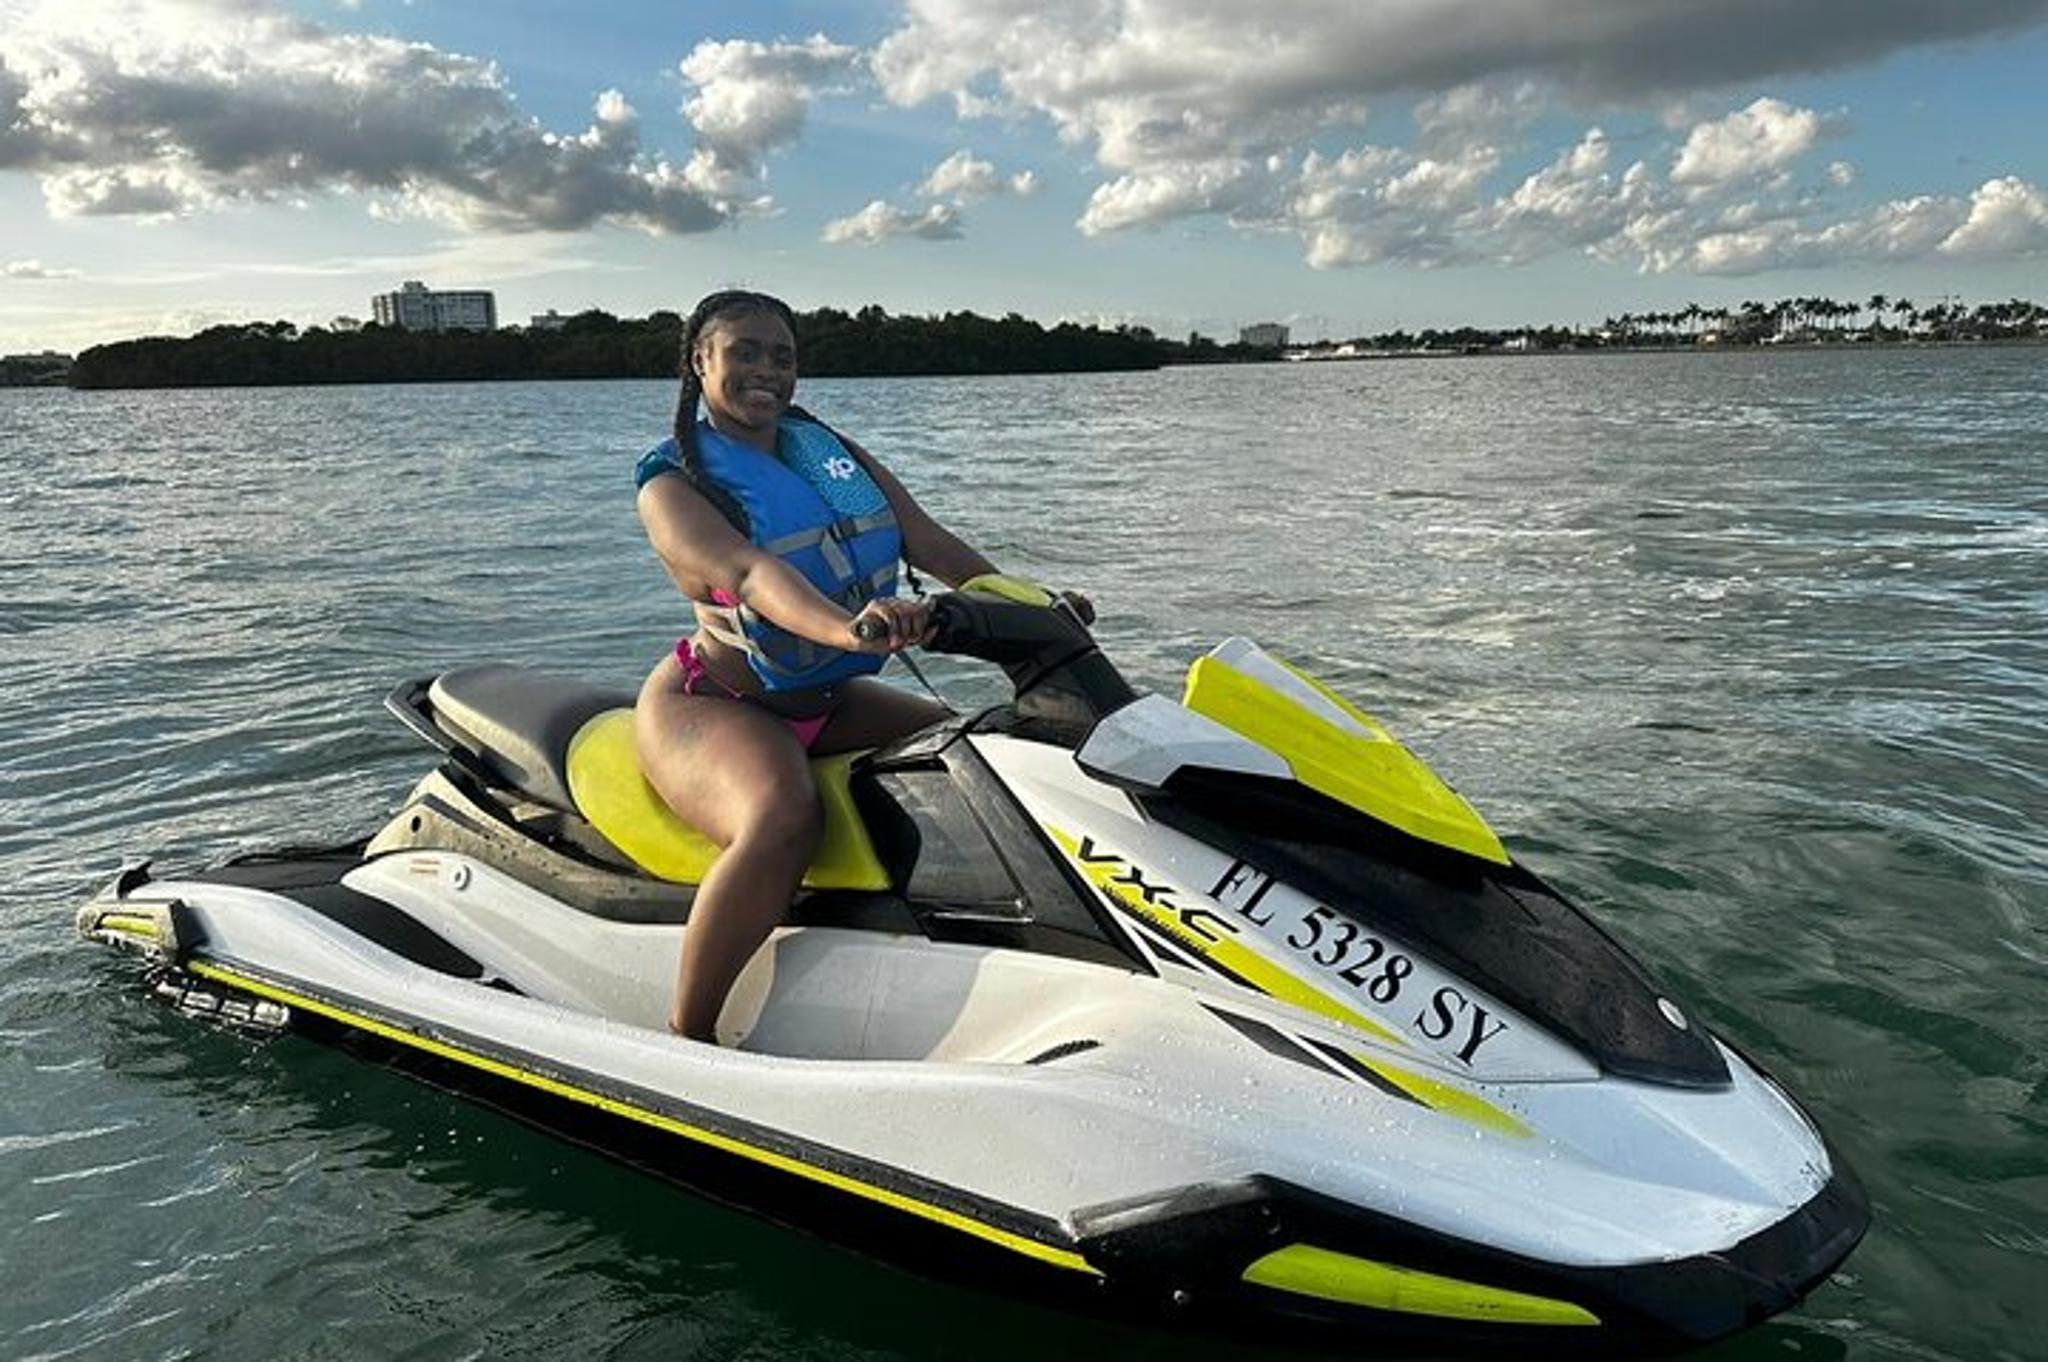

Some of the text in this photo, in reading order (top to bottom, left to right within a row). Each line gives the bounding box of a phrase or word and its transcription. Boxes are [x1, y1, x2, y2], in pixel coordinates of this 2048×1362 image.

[1078, 837, 1240, 941] VX-C
[1207, 859, 1508, 1066] FL 5328 SY
